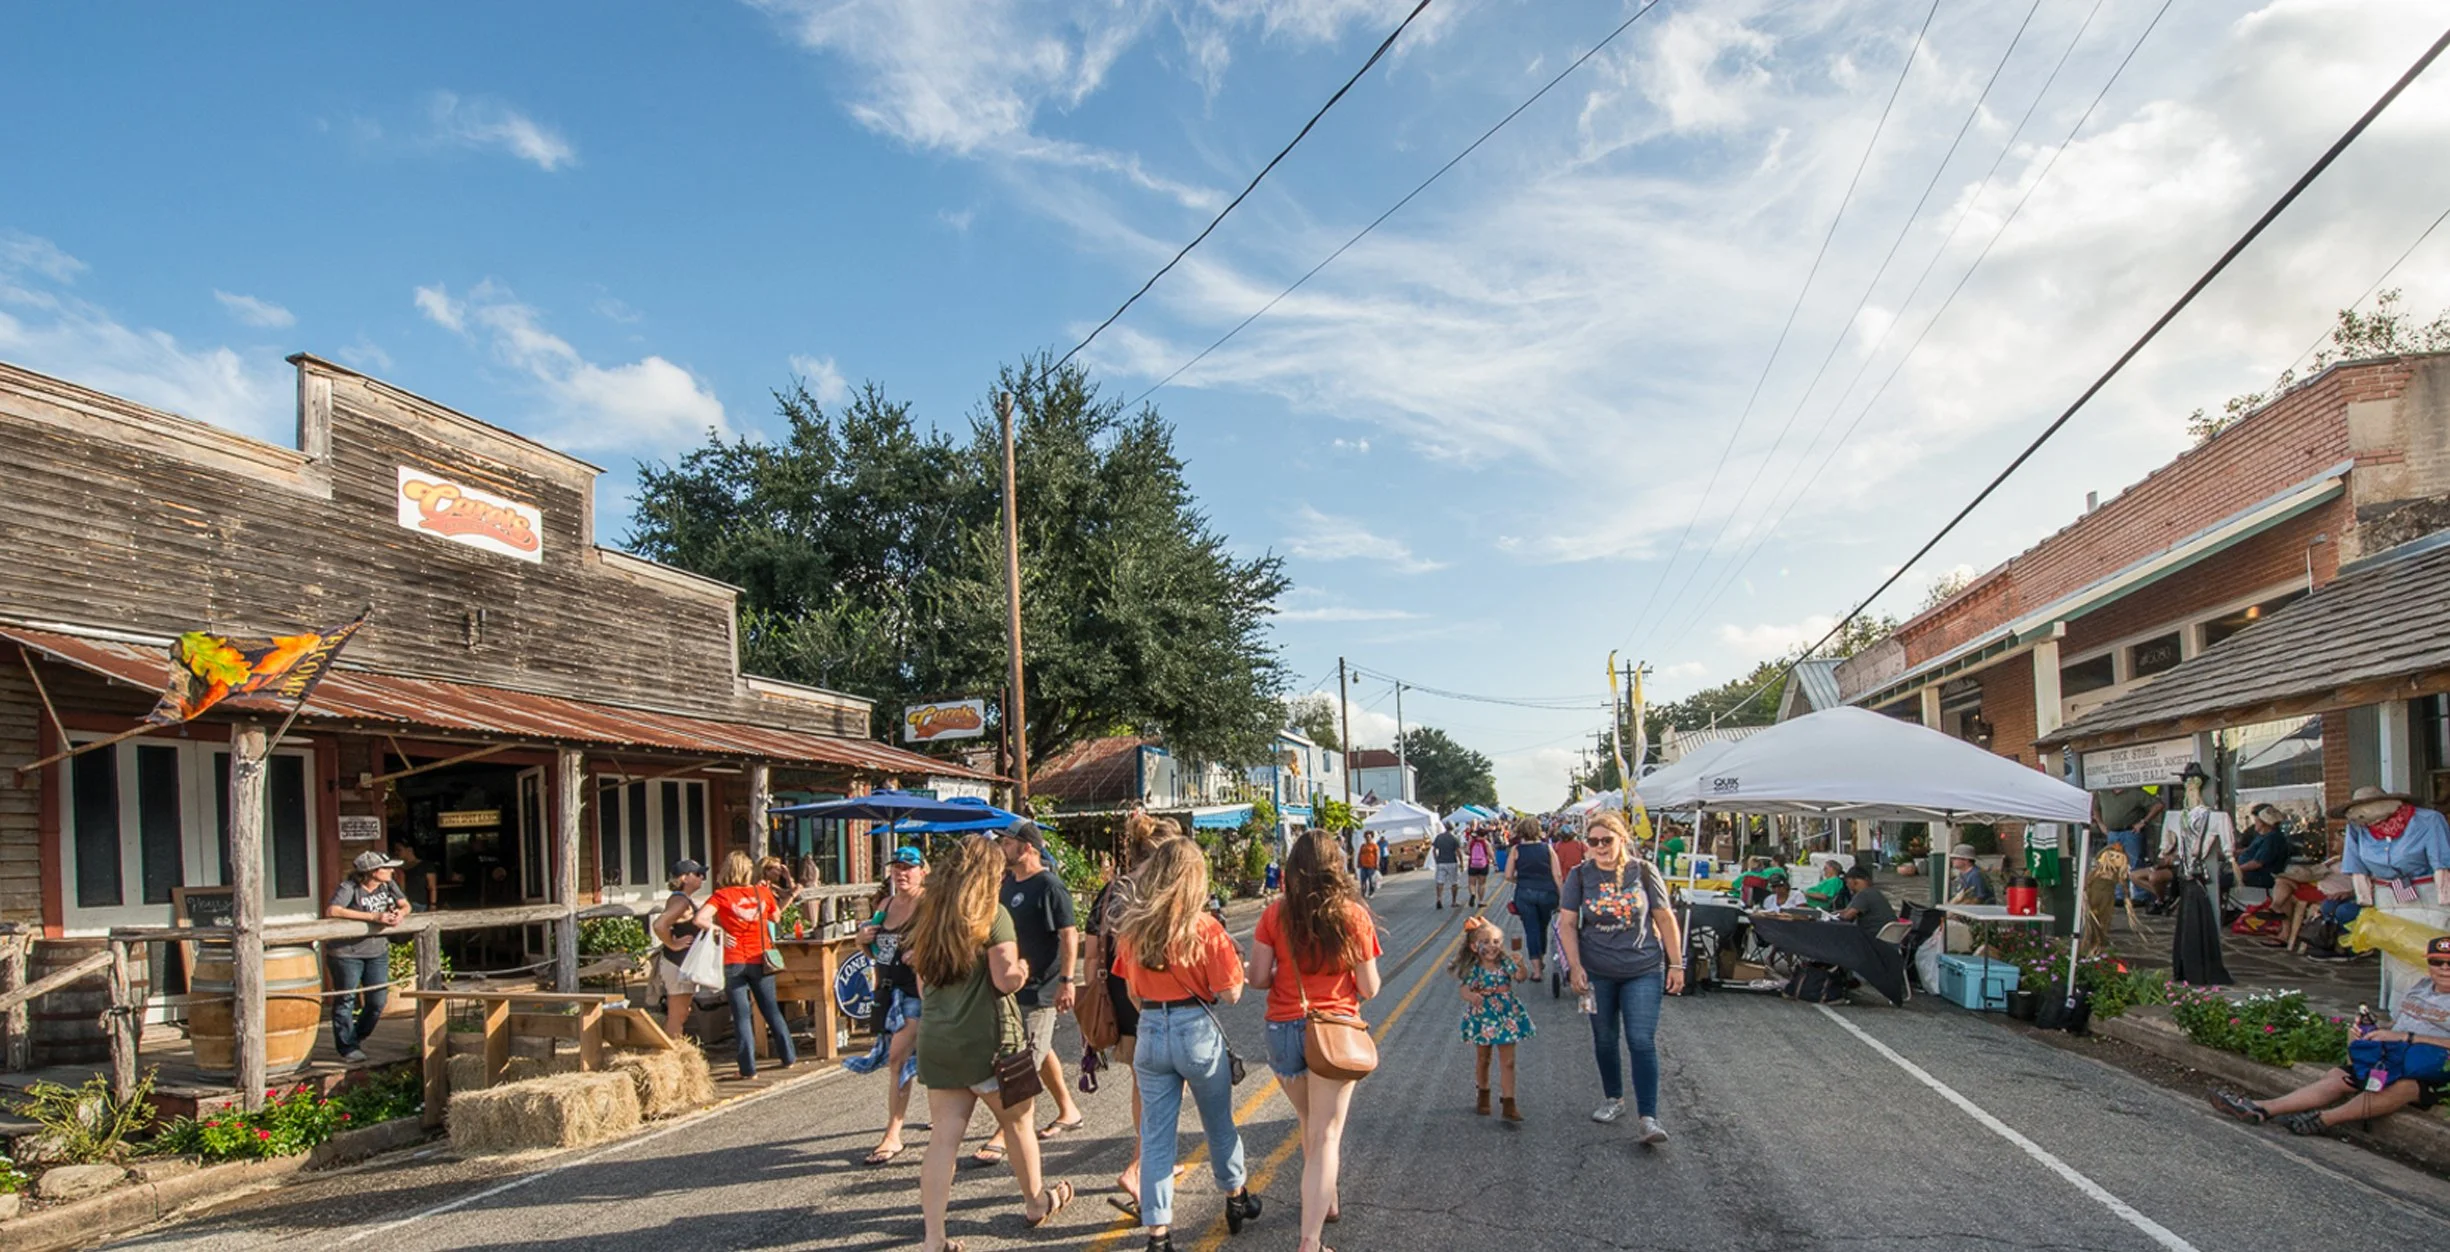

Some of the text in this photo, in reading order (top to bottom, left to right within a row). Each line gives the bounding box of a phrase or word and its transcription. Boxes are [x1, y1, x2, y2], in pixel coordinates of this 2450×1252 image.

[2131, 746, 2158, 760] STORE
[2107, 769, 2168, 785] MEETING HALL
[840, 955, 868, 986] LONE
